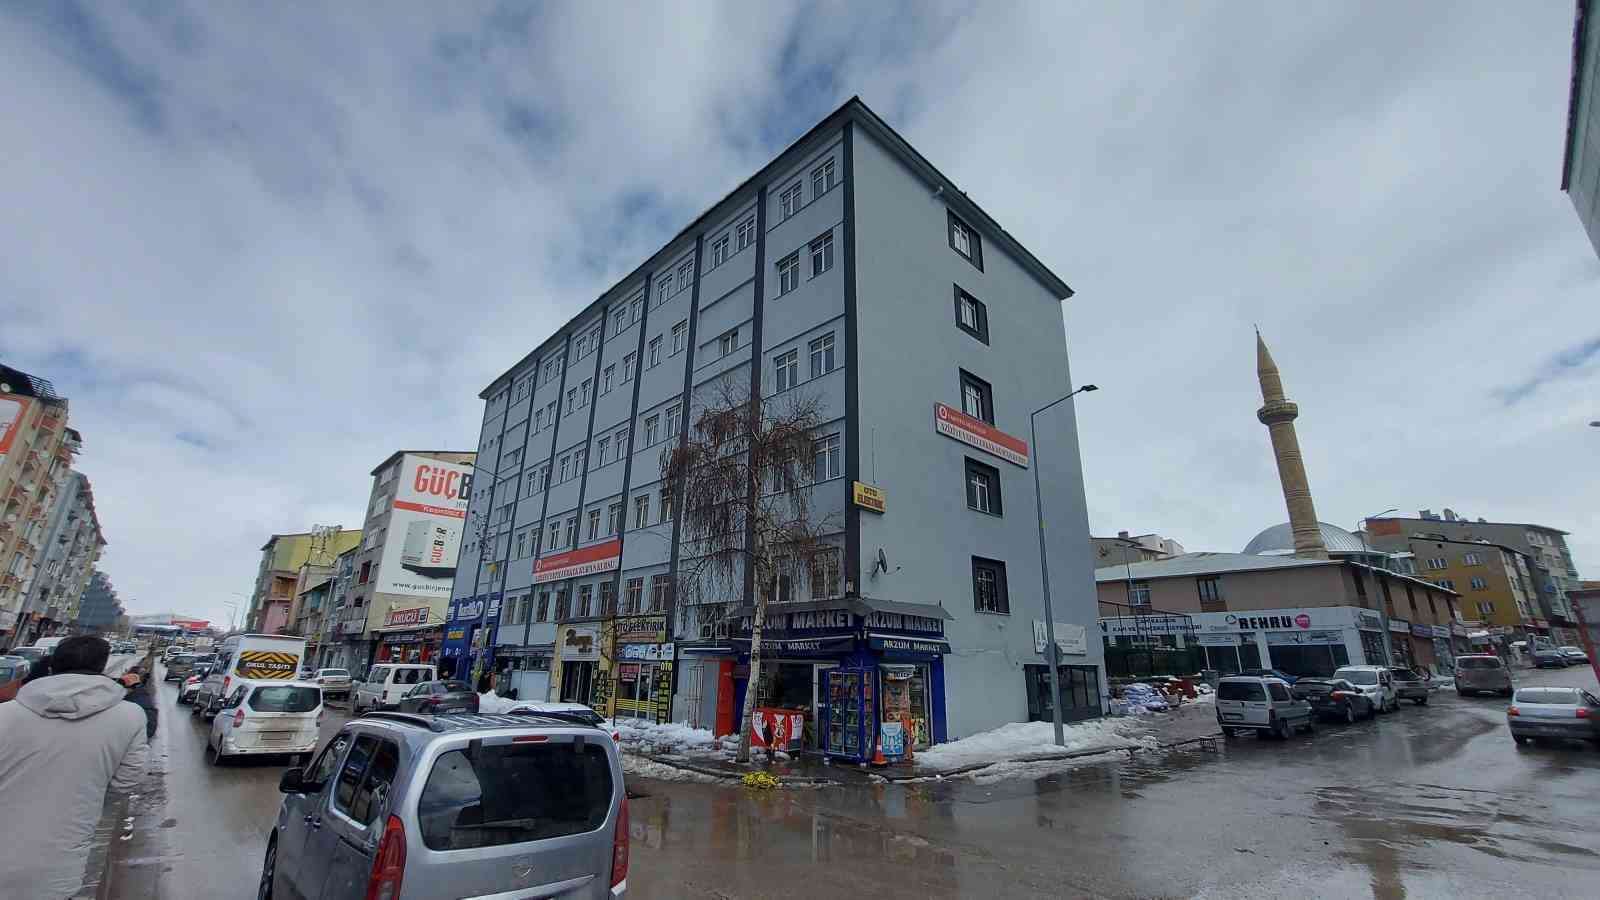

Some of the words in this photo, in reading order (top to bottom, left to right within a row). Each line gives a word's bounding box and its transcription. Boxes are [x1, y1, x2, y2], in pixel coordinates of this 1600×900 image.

[792, 609, 855, 629] MARKET
[864, 610, 902, 629] ARZUM
[904, 613, 944, 632] MARKET
[883, 640, 910, 649] ARZUM
